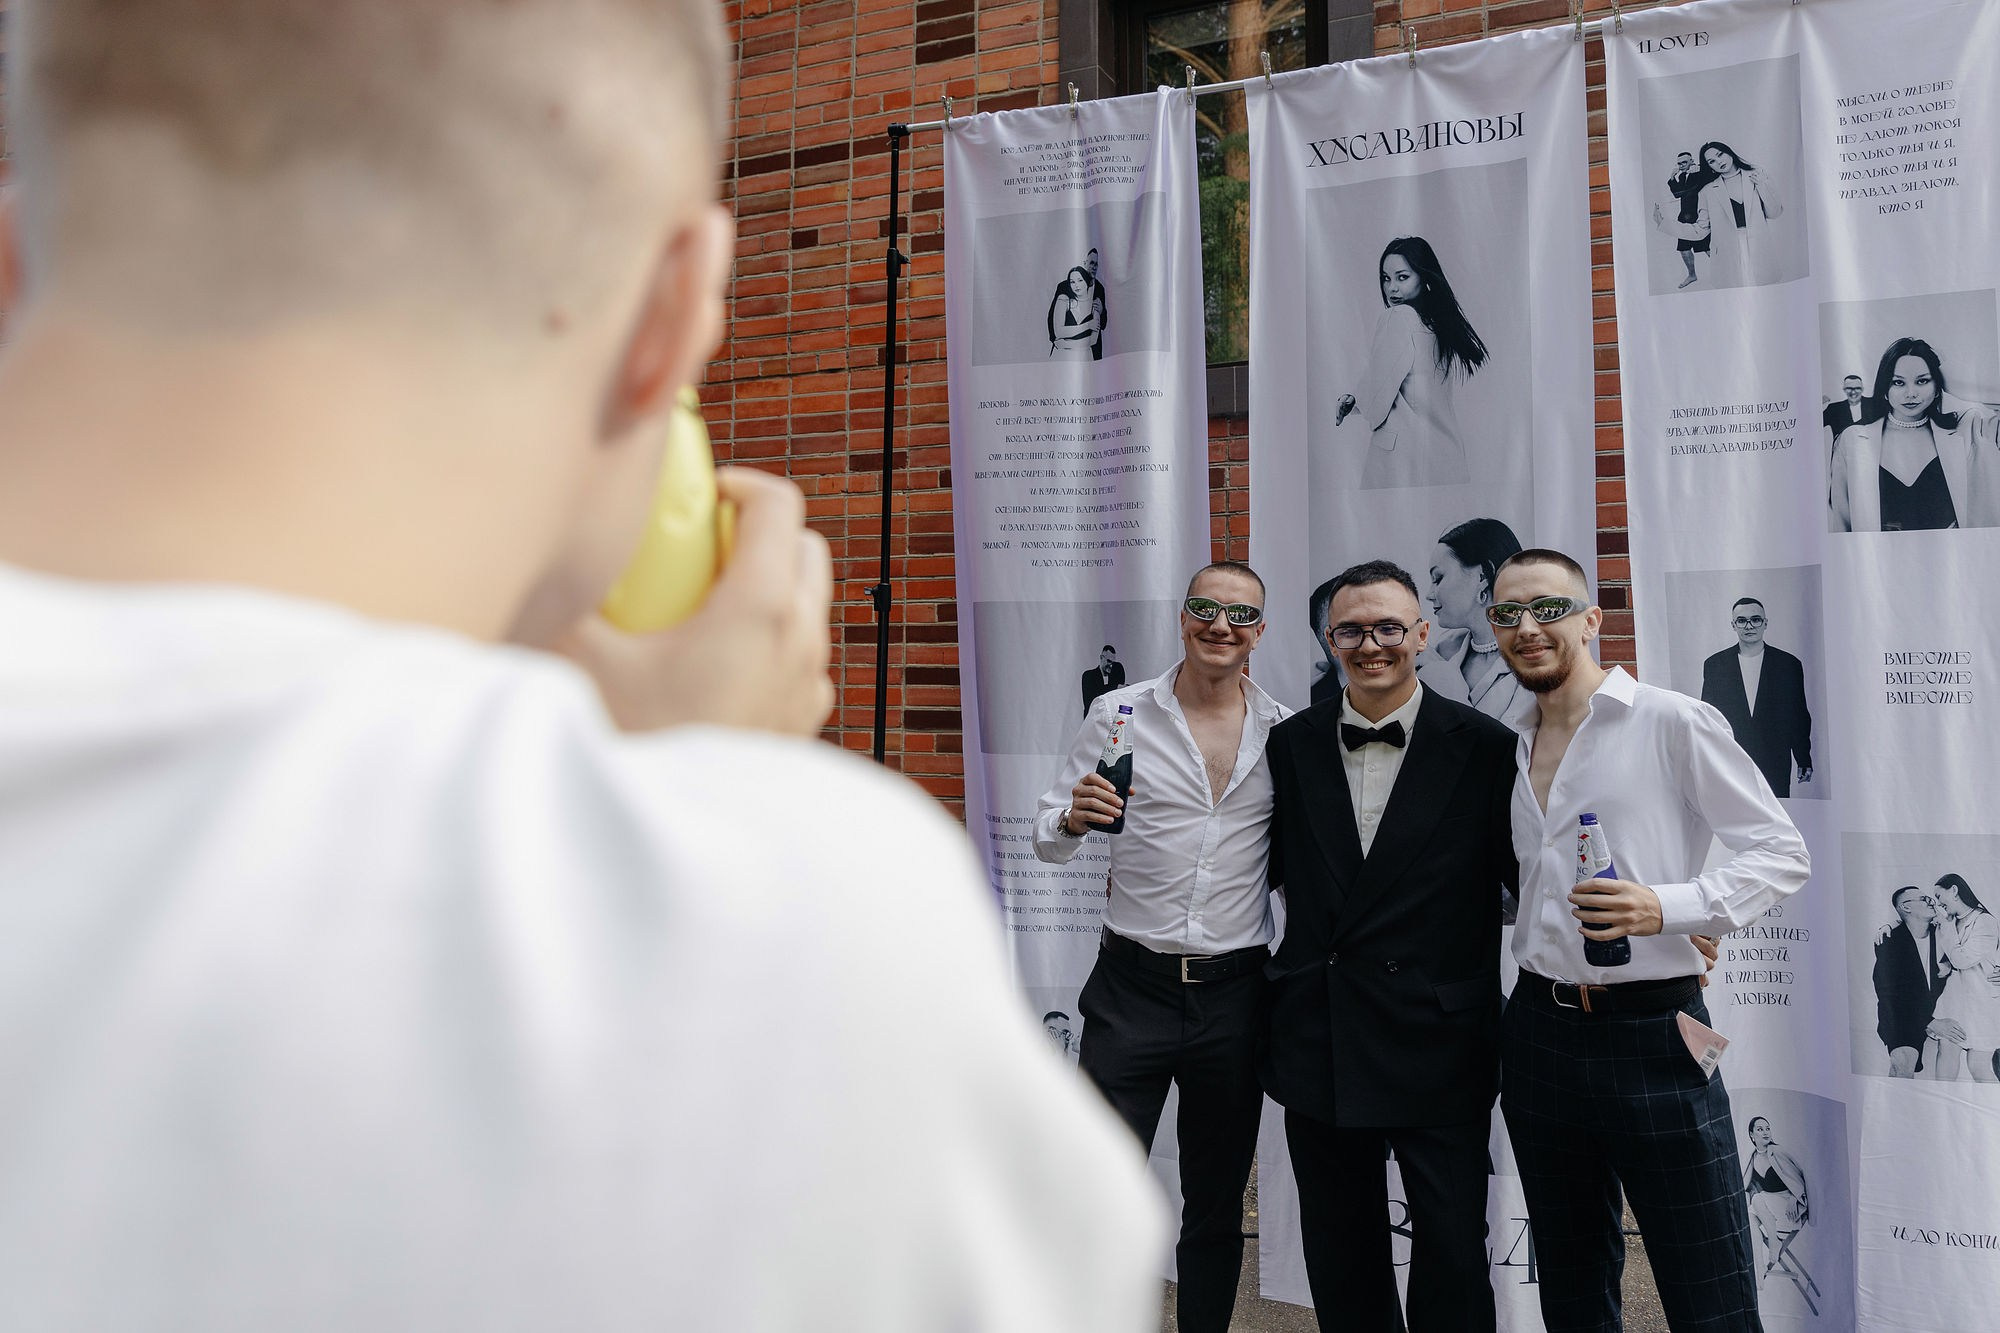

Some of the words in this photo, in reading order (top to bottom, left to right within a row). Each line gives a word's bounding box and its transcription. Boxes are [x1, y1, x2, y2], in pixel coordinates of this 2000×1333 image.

[1837, 91, 1888, 108] МЫСЛИ
[1890, 89, 1900, 99] О
[1903, 80, 1953, 97] ТЕБЕ
[1839, 117, 1847, 126] В
[1851, 107, 1894, 125] МОЕЙ
[1898, 99, 1957, 116] ГОЛОВЕ
[1836, 134, 1858, 144] НЕ
[1860, 126, 1910, 144] ДАЮТ
[1912, 118, 1961, 133] ПОКОЯ
[1839, 147, 1895, 162] ТОЛЬКО
[1898, 142, 1924, 155] ТЫ
[1927, 140, 1941, 150] И
[1839, 165, 1899, 181] ТОЛЬКО
[1902, 161, 1928, 173] ТЫ
[1931, 159, 1945, 169] И
[1948, 157, 1957, 167] Я
[1839, 184, 1899, 199] ПРАВДА
[1878, 201, 1911, 214] КТО
[1914, 199, 1924, 210] Я
[978, 401, 1010, 409] ЛЮБОВЬ
[1040, 398, 1067, 406] КОГДА
[1070, 397, 1104, 406] ХОЧЕШЬ
[1669, 407, 1718, 419] ЛЮБИТЬ
[1720, 404, 1754, 416] ТЕБЯ
[1757, 401, 1789, 414] БУДУ
[1002, 416, 1022, 425] НЕЙ
[1044, 416, 1087, 424] ЧЕТЫРЕ
[1120, 408, 1142, 417] ГОДА
[1665, 425, 1727, 438] УВАЖАТЬ
[1728, 422, 1762, 433] ТЕБЯ
[1764, 418, 1797, 432] БУДУ
[1005, 435, 1033, 443] КОГДА
[1077, 433, 1112, 441] БЕЖАТЬ
[1670, 444, 1708, 456] БАБКИ
[1708, 442, 1759, 454] ДАВАТЬ
[1761, 438, 1794, 451] БУДУ
[988, 453, 1002, 461] ОТ
[1004, 451, 1055, 460] ВЕСЕННЕЙ
[1057, 452, 1084, 460] ГРОЗЫ
[1139, 464, 1169, 472] ЯГОДЫ
[994, 506, 1031, 514] ОСЕНЬЮ
[1032, 505, 1074, 513] ВМЕСТЕ
[1008, 523, 1073, 531] ЗАКЛЕИВАТЬ
[1074, 523, 1098, 531] ОКНА
[1020, 541, 1070, 549] ПОМОГАТЬ
[1120, 538, 1157, 547] НАСМОРК
[1031, 559, 1038, 567] И
[1081, 558, 1114, 567] ВЕЧЕРА
[1884, 651, 1972, 665] ВМЕСТЕ
[1885, 671, 1973, 685] ВМЕСТЕ
[1886, 690, 1974, 705] ВМЕСТЕ
[1001, 816, 1033, 825] СМОТРИ
[1720, 926, 1810, 942] ИЗНАНИЕ
[1727, 949, 1736, 962] В
[1739, 947, 1791, 962] МОЕЙ
[1724, 971, 1734, 984] К
[1737, 970, 1794, 985] ТЕБЕ
[1730, 992, 1792, 1006] ЛЮБВИ
[1889, 1225, 1909, 1240] И
[1911, 1228, 1941, 1246] ДО
